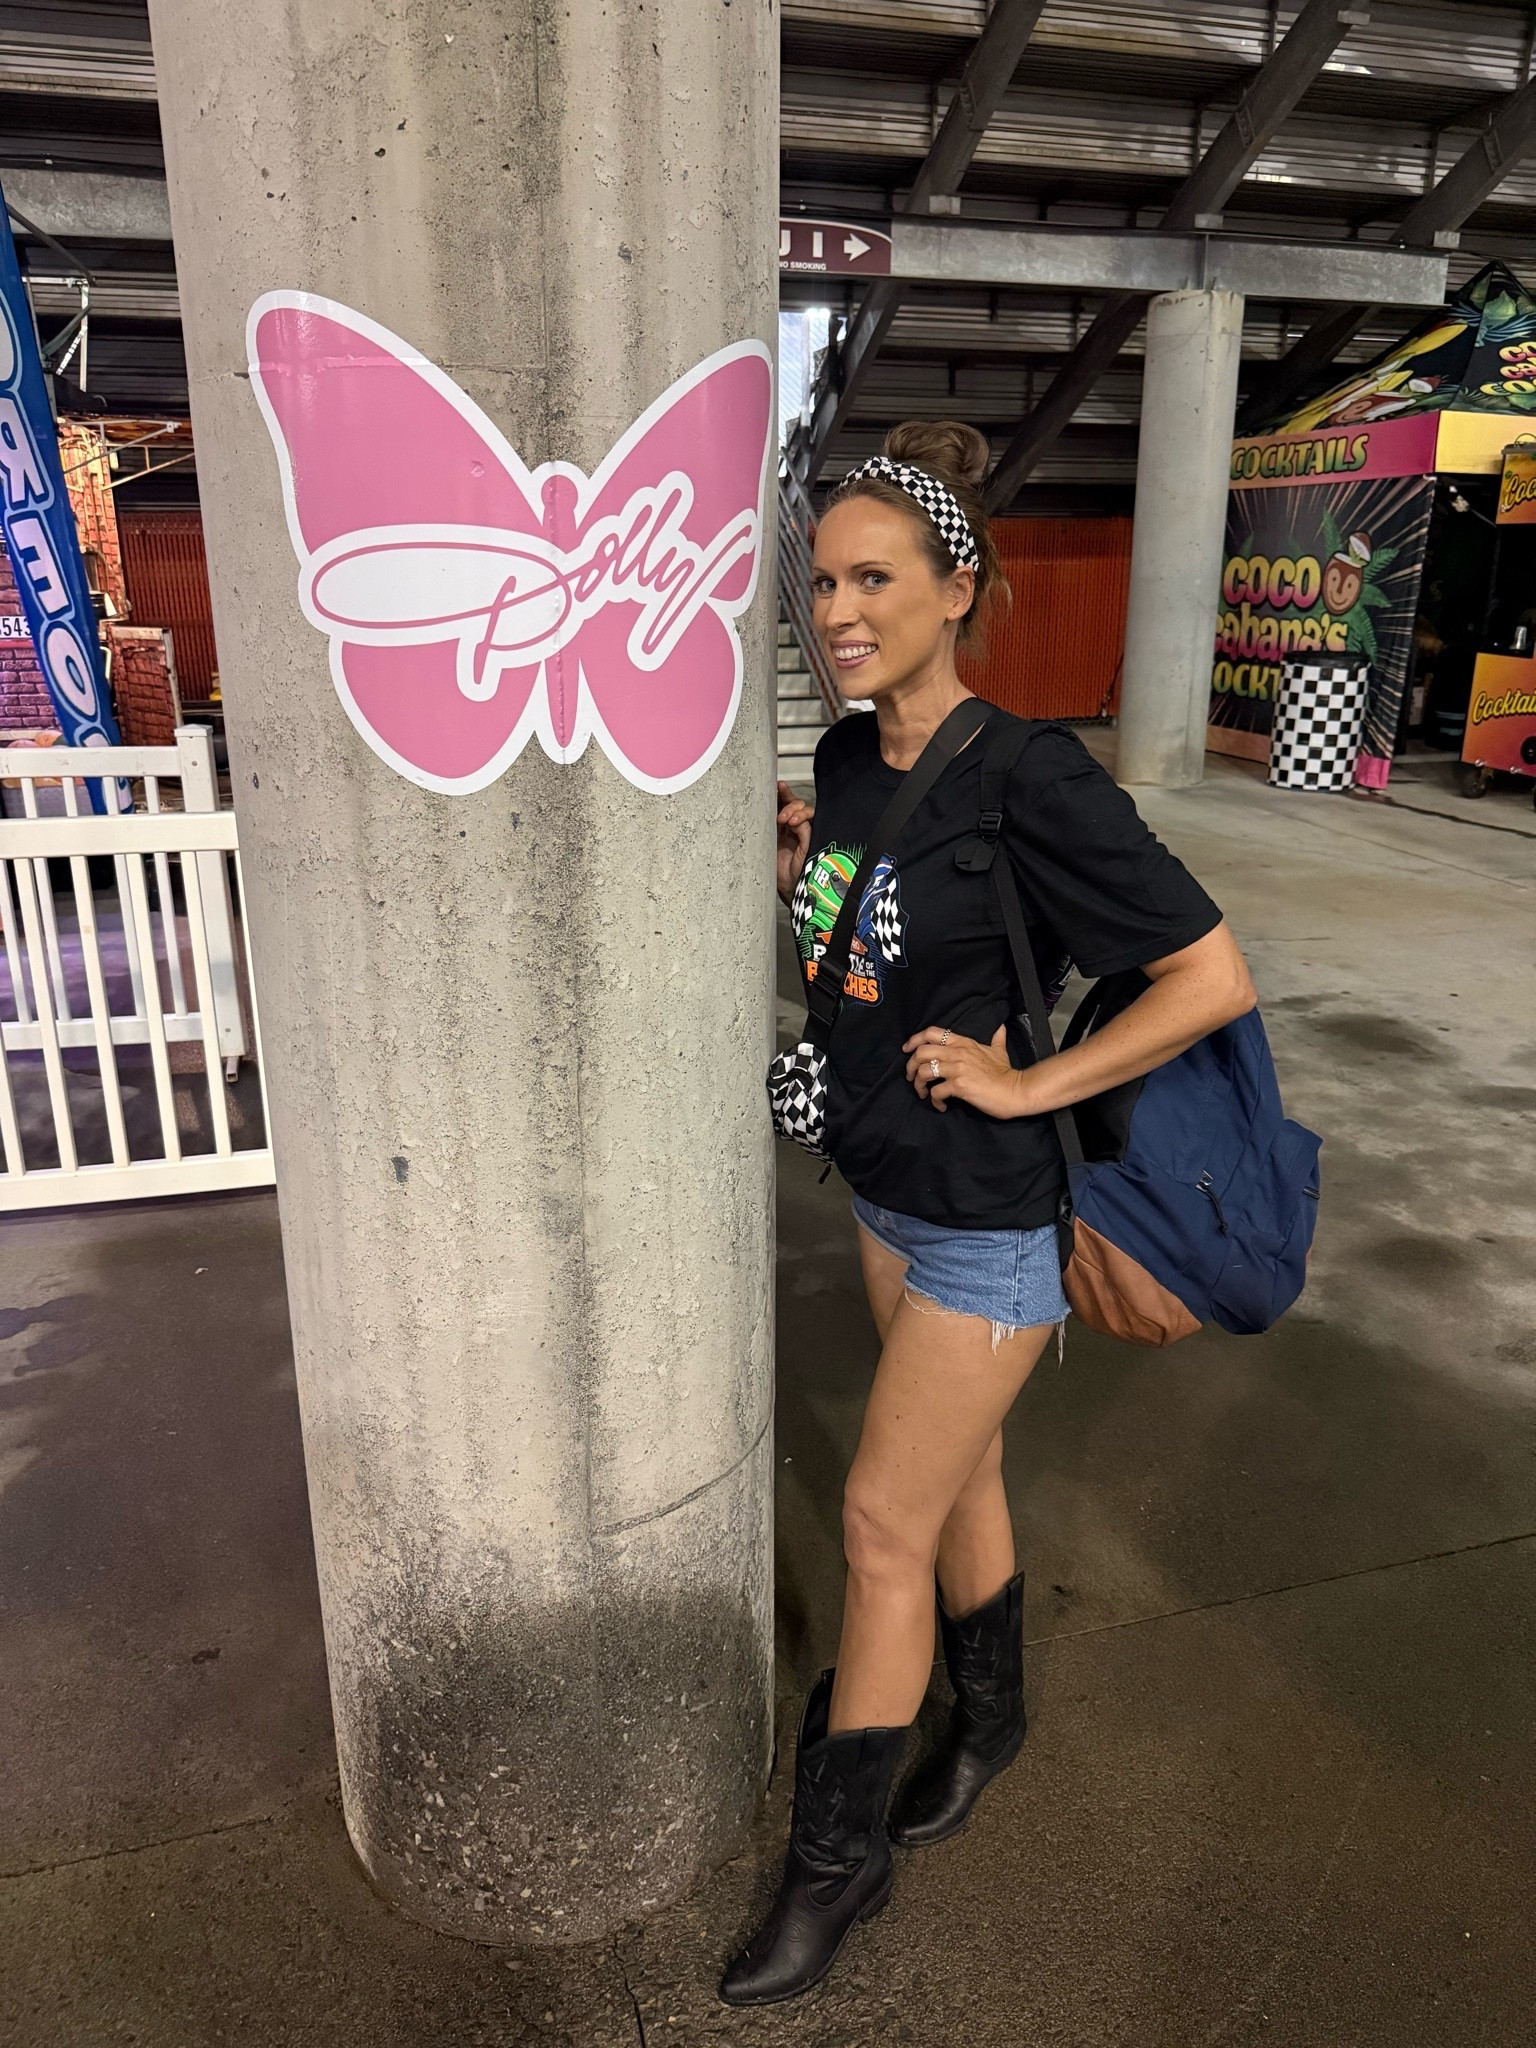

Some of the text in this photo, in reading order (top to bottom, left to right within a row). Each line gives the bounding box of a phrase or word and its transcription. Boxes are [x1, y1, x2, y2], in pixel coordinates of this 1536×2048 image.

[790, 261, 827, 271] SMOKING
[1230, 433, 1369, 480] COCKTAILS
[311, 488, 752, 685] Dolly
[866, 961, 875, 970] OF
[865, 969, 876, 978] THE
